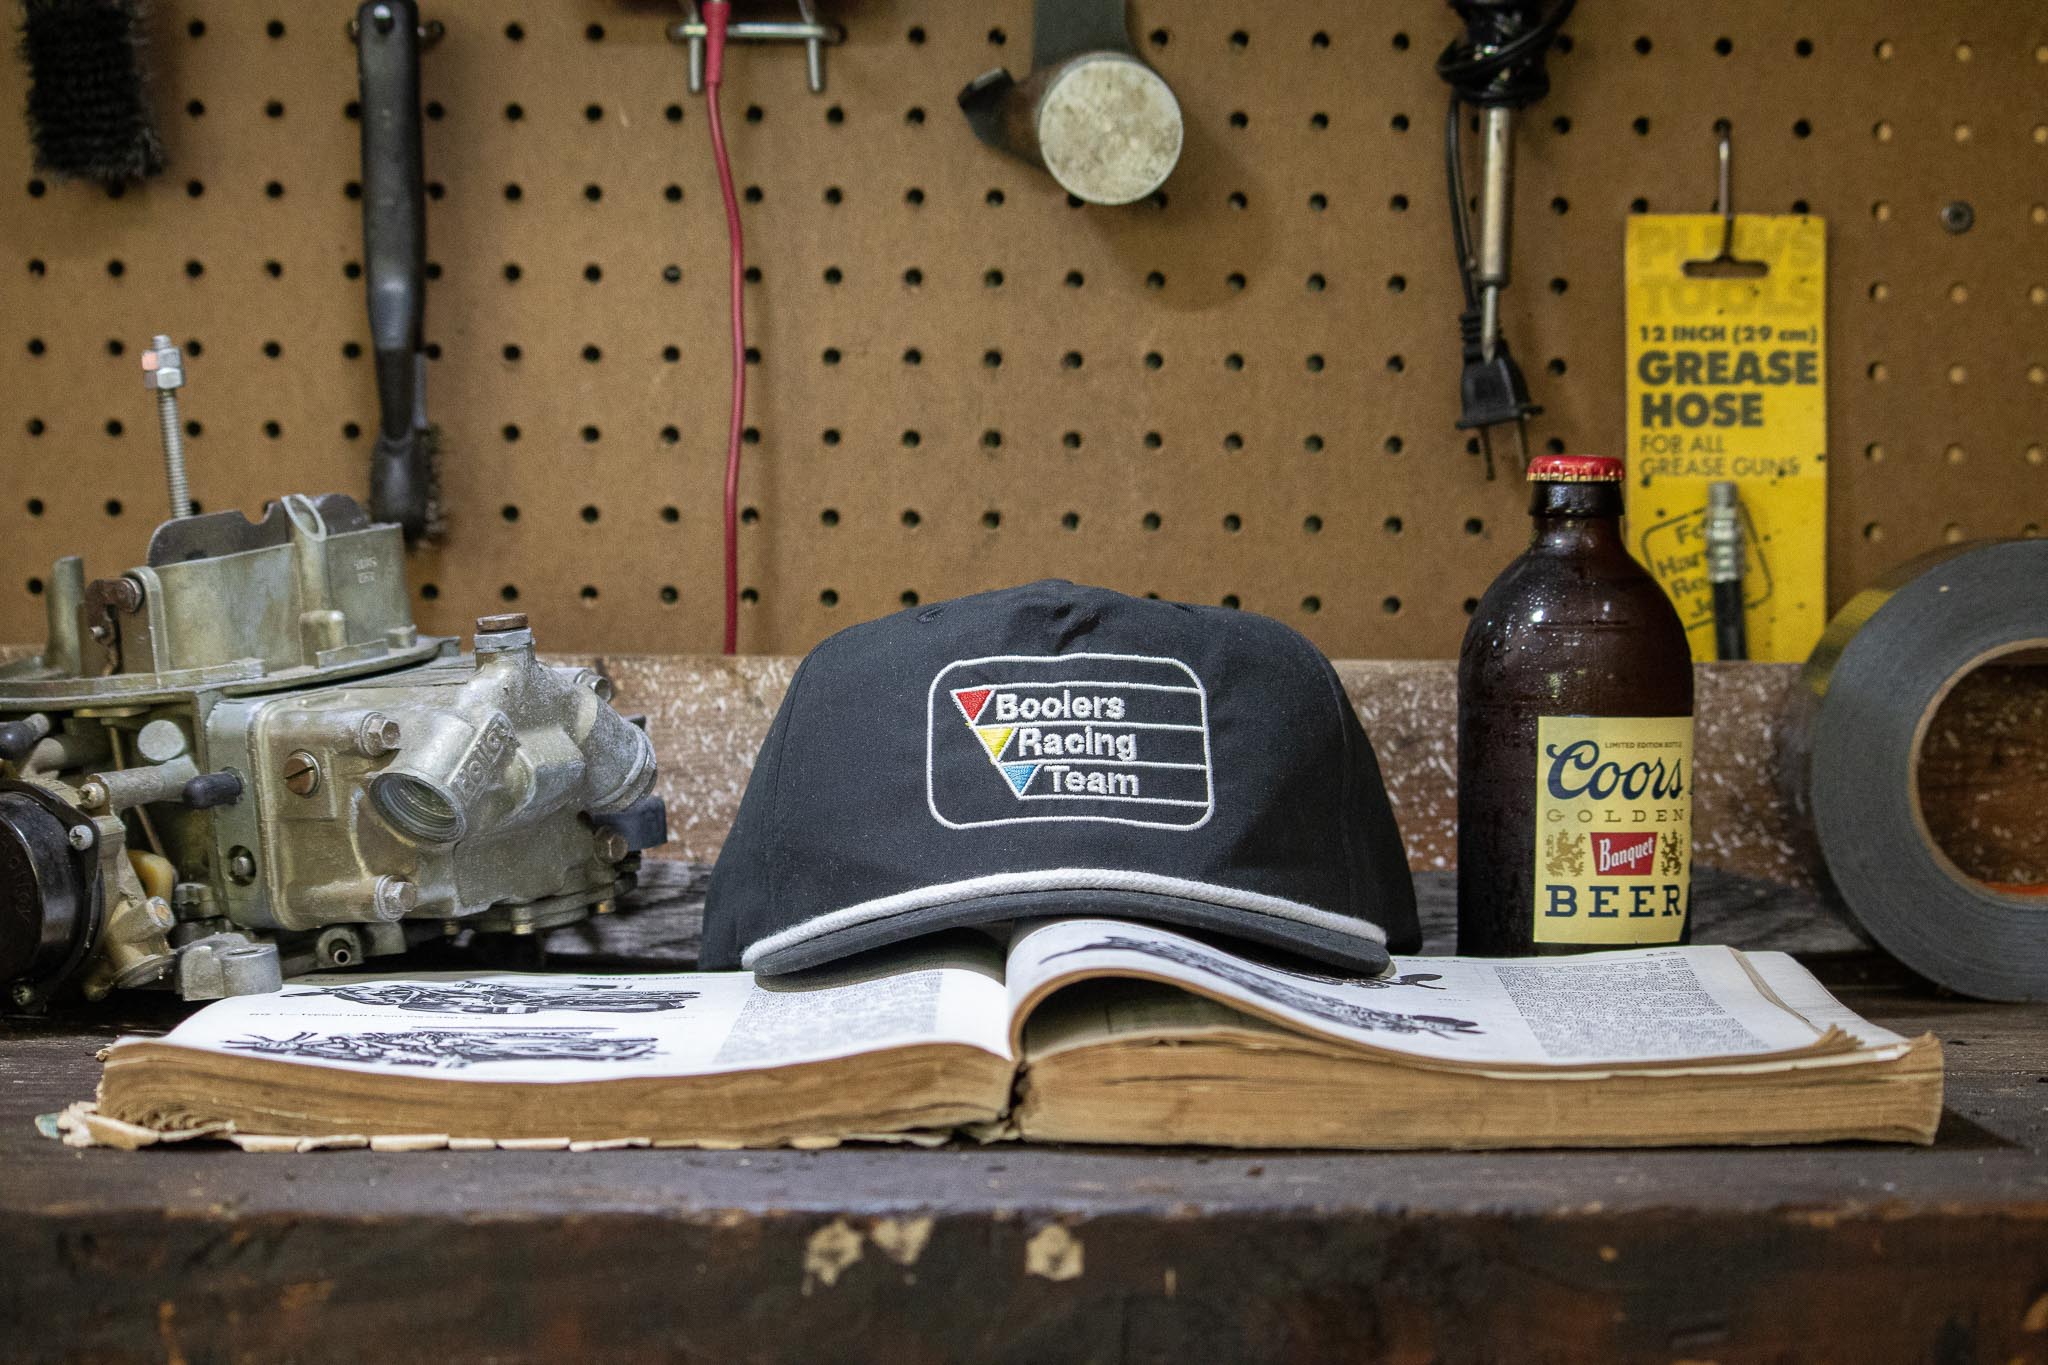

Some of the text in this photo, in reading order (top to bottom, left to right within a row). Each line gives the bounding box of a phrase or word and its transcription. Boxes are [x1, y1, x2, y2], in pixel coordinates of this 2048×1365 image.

[1640, 325, 1818, 345] 12 INCH (29 cm)
[1638, 350, 1818, 386] GREASE
[1641, 392, 1764, 428] HOSE
[1640, 434, 1724, 453] FOR ALL
[1639, 457, 1800, 478] GREASE GUNS
[995, 689, 1126, 721] Boolers
[1018, 726, 1138, 762] Racing
[1604, 741, 1635, 749] LIMITED
[1637, 741, 1663, 749] EDITION
[1044, 765, 1140, 796] Team
[1546, 739, 1684, 801] Coors
[1546, 808, 1684, 824] GOLDEN
[1599, 836, 1654, 873] Banquet
[1545, 884, 1681, 918] BEER
